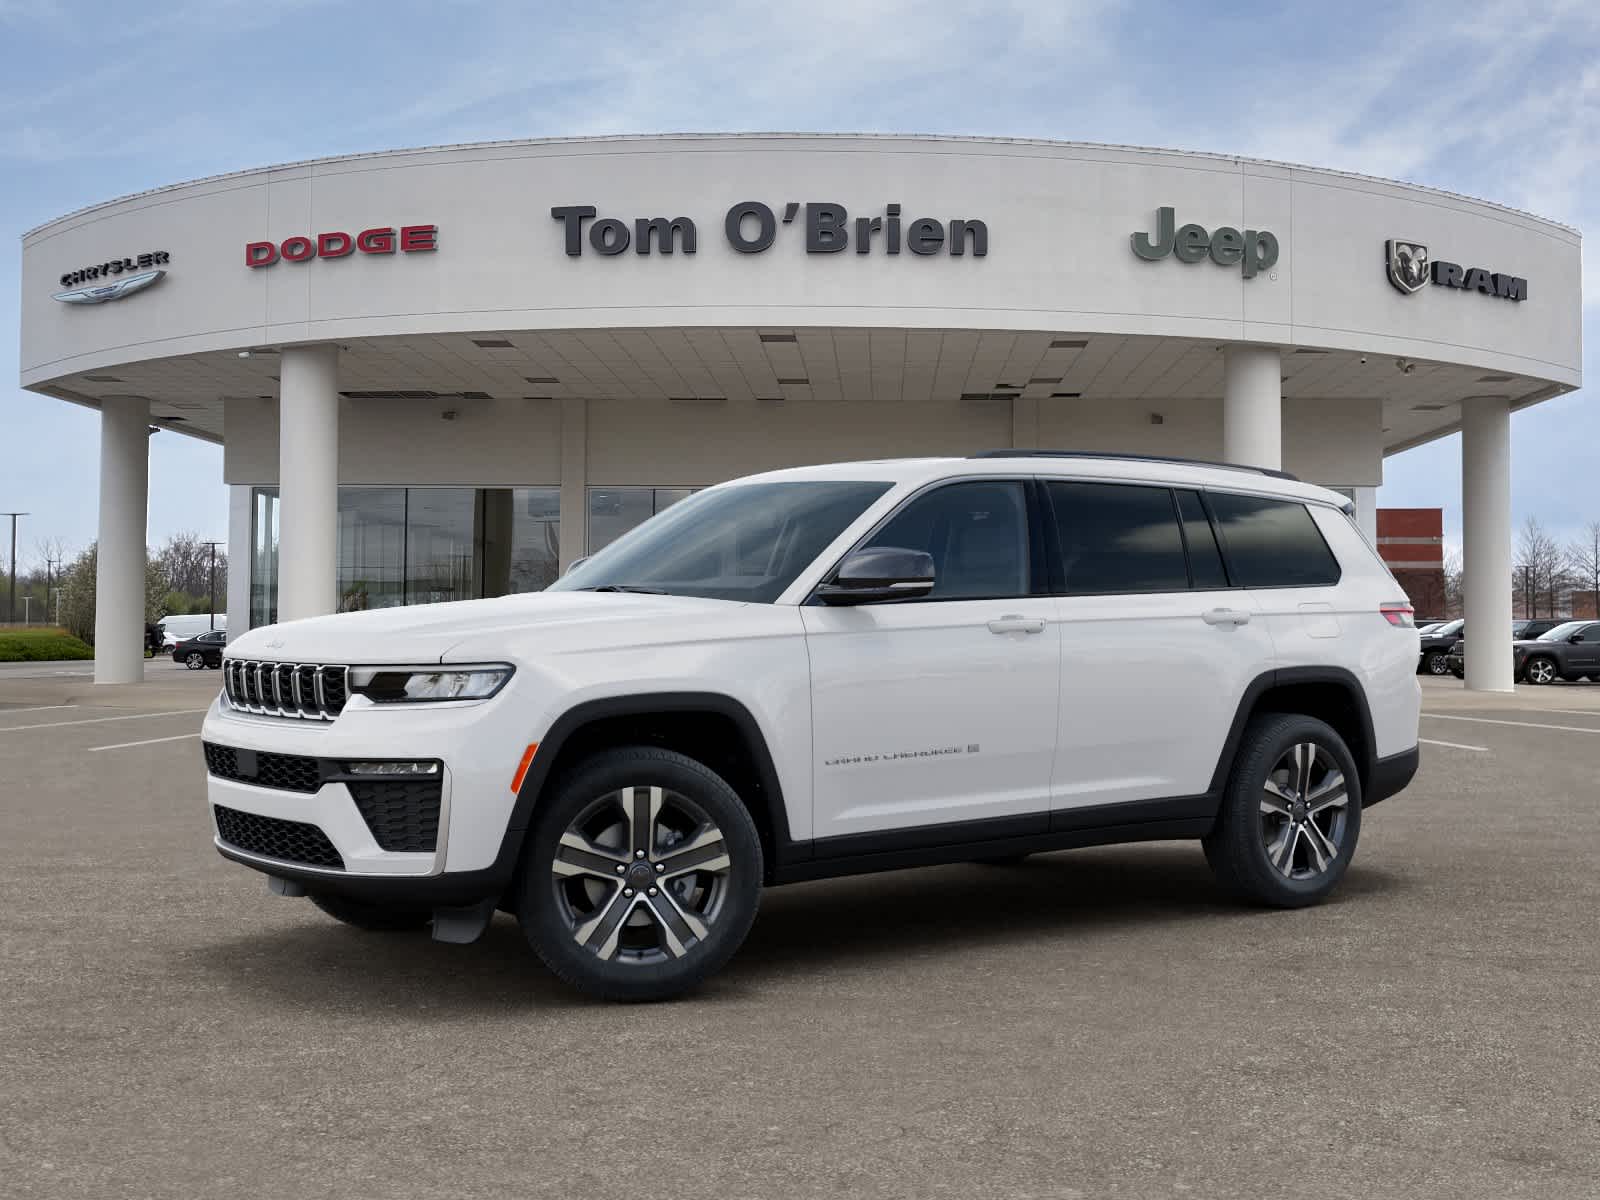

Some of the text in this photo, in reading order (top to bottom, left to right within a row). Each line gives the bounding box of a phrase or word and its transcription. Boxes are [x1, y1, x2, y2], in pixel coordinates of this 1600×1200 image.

[245, 224, 437, 268] DODGE
[551, 200, 988, 257] Tom O'Brien
[1130, 206, 1279, 279] Jeep
[60, 249, 169, 287] CHRYSLER
[1431, 260, 1528, 301] RAM
